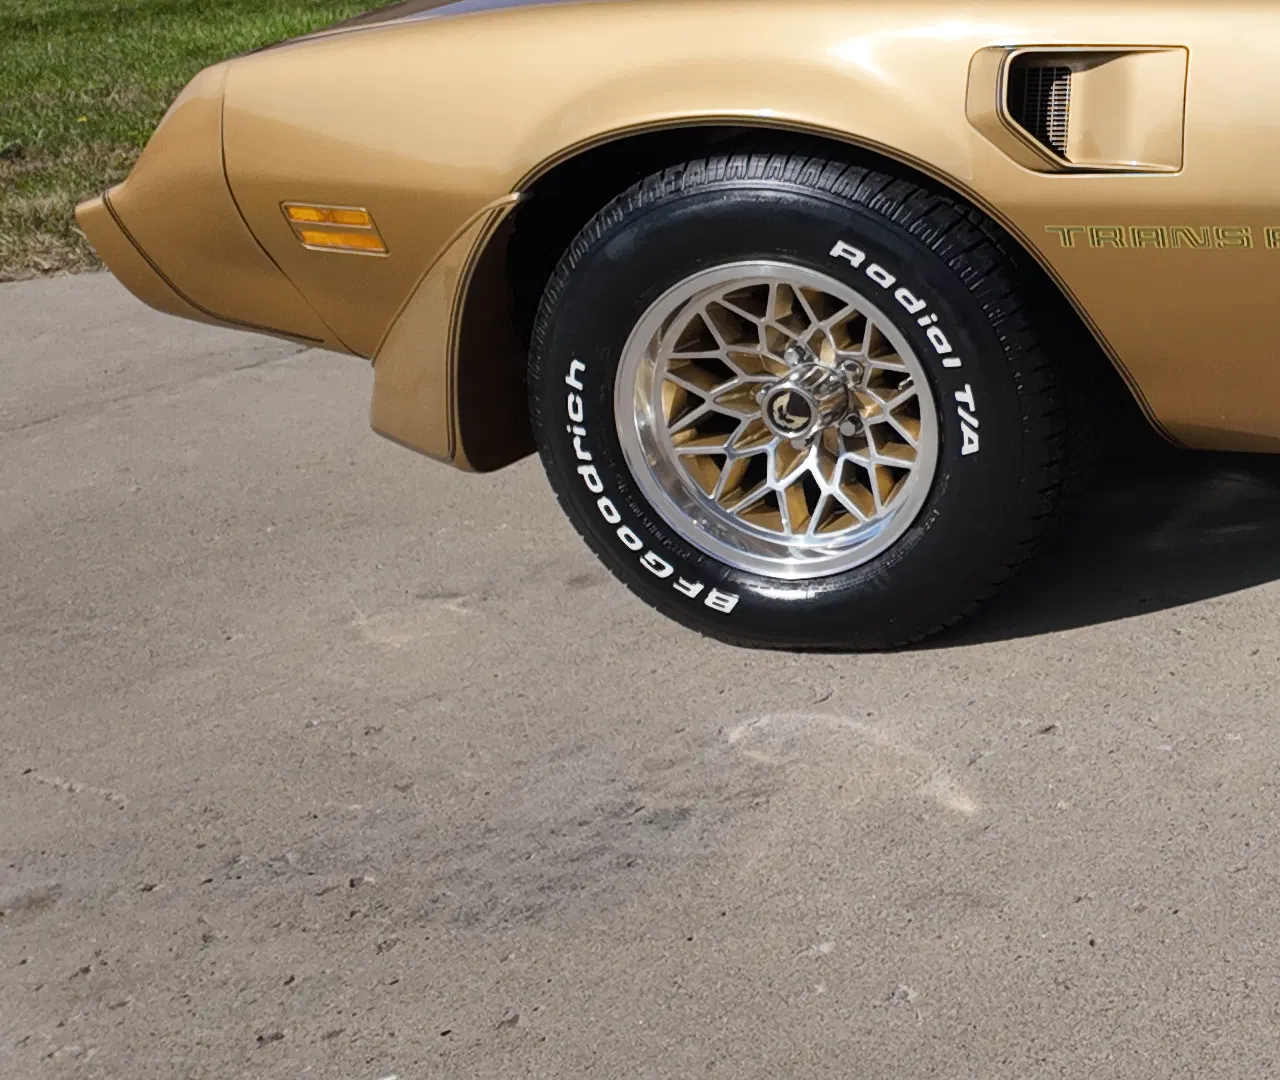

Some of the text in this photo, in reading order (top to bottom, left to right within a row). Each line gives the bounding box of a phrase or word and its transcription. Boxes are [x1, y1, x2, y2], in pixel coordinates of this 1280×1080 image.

[1044, 224, 1254, 250] TRANS
[829, 239, 980, 456] Radial T/A
[564, 359, 740, 614] BFGoodrich
